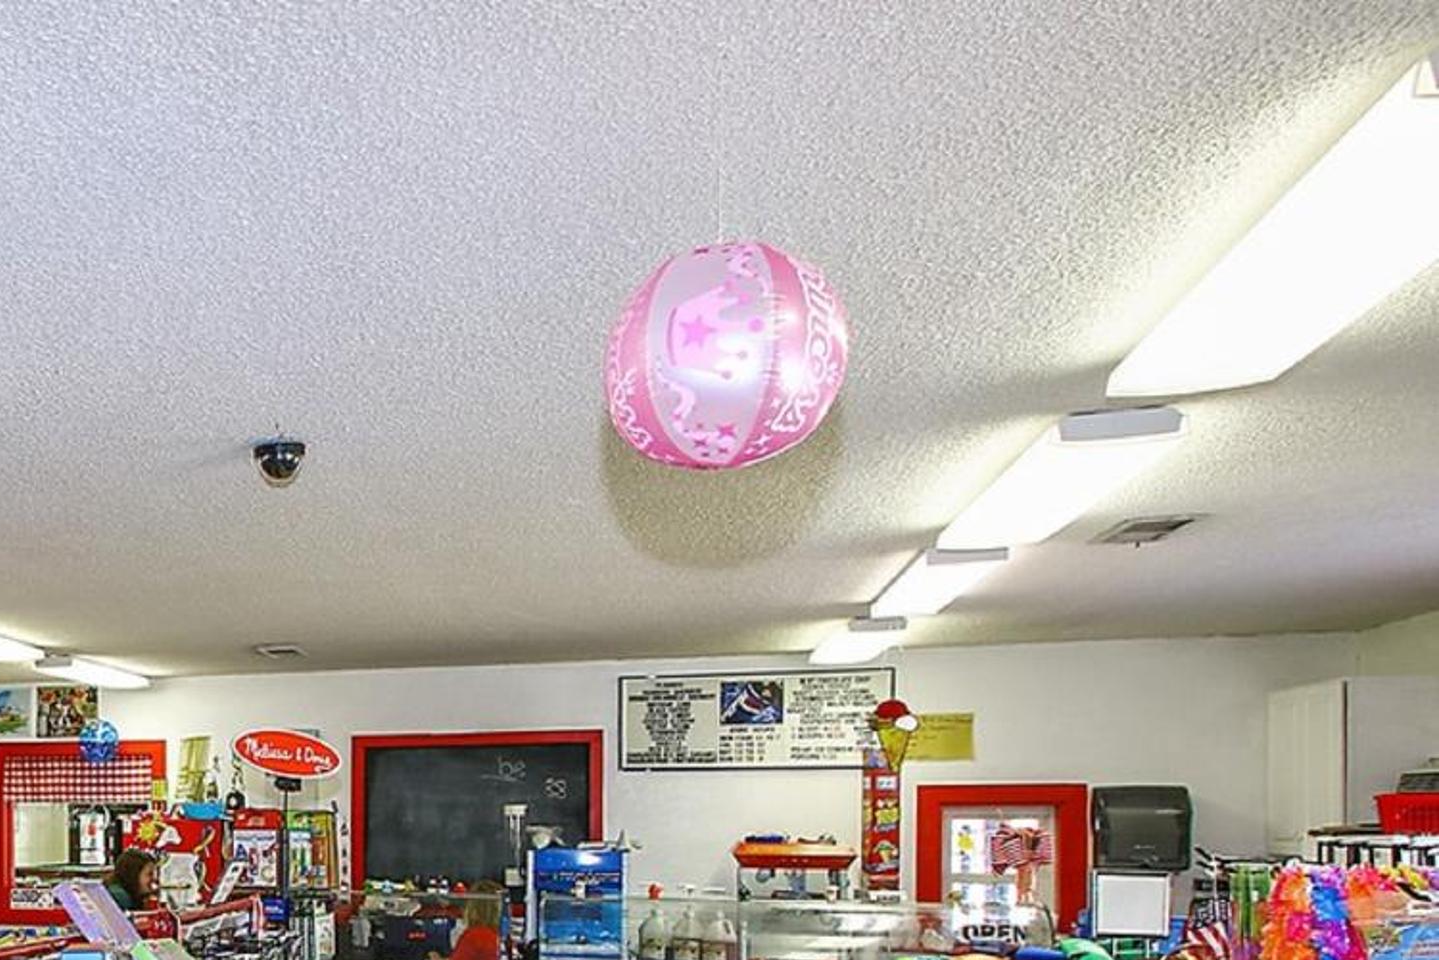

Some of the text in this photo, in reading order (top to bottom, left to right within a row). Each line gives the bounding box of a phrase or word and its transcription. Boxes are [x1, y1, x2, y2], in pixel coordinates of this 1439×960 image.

[243, 738, 294, 762] Melissa
[303, 746, 335, 772] Doug
[962, 924, 1026, 943] OPEN
